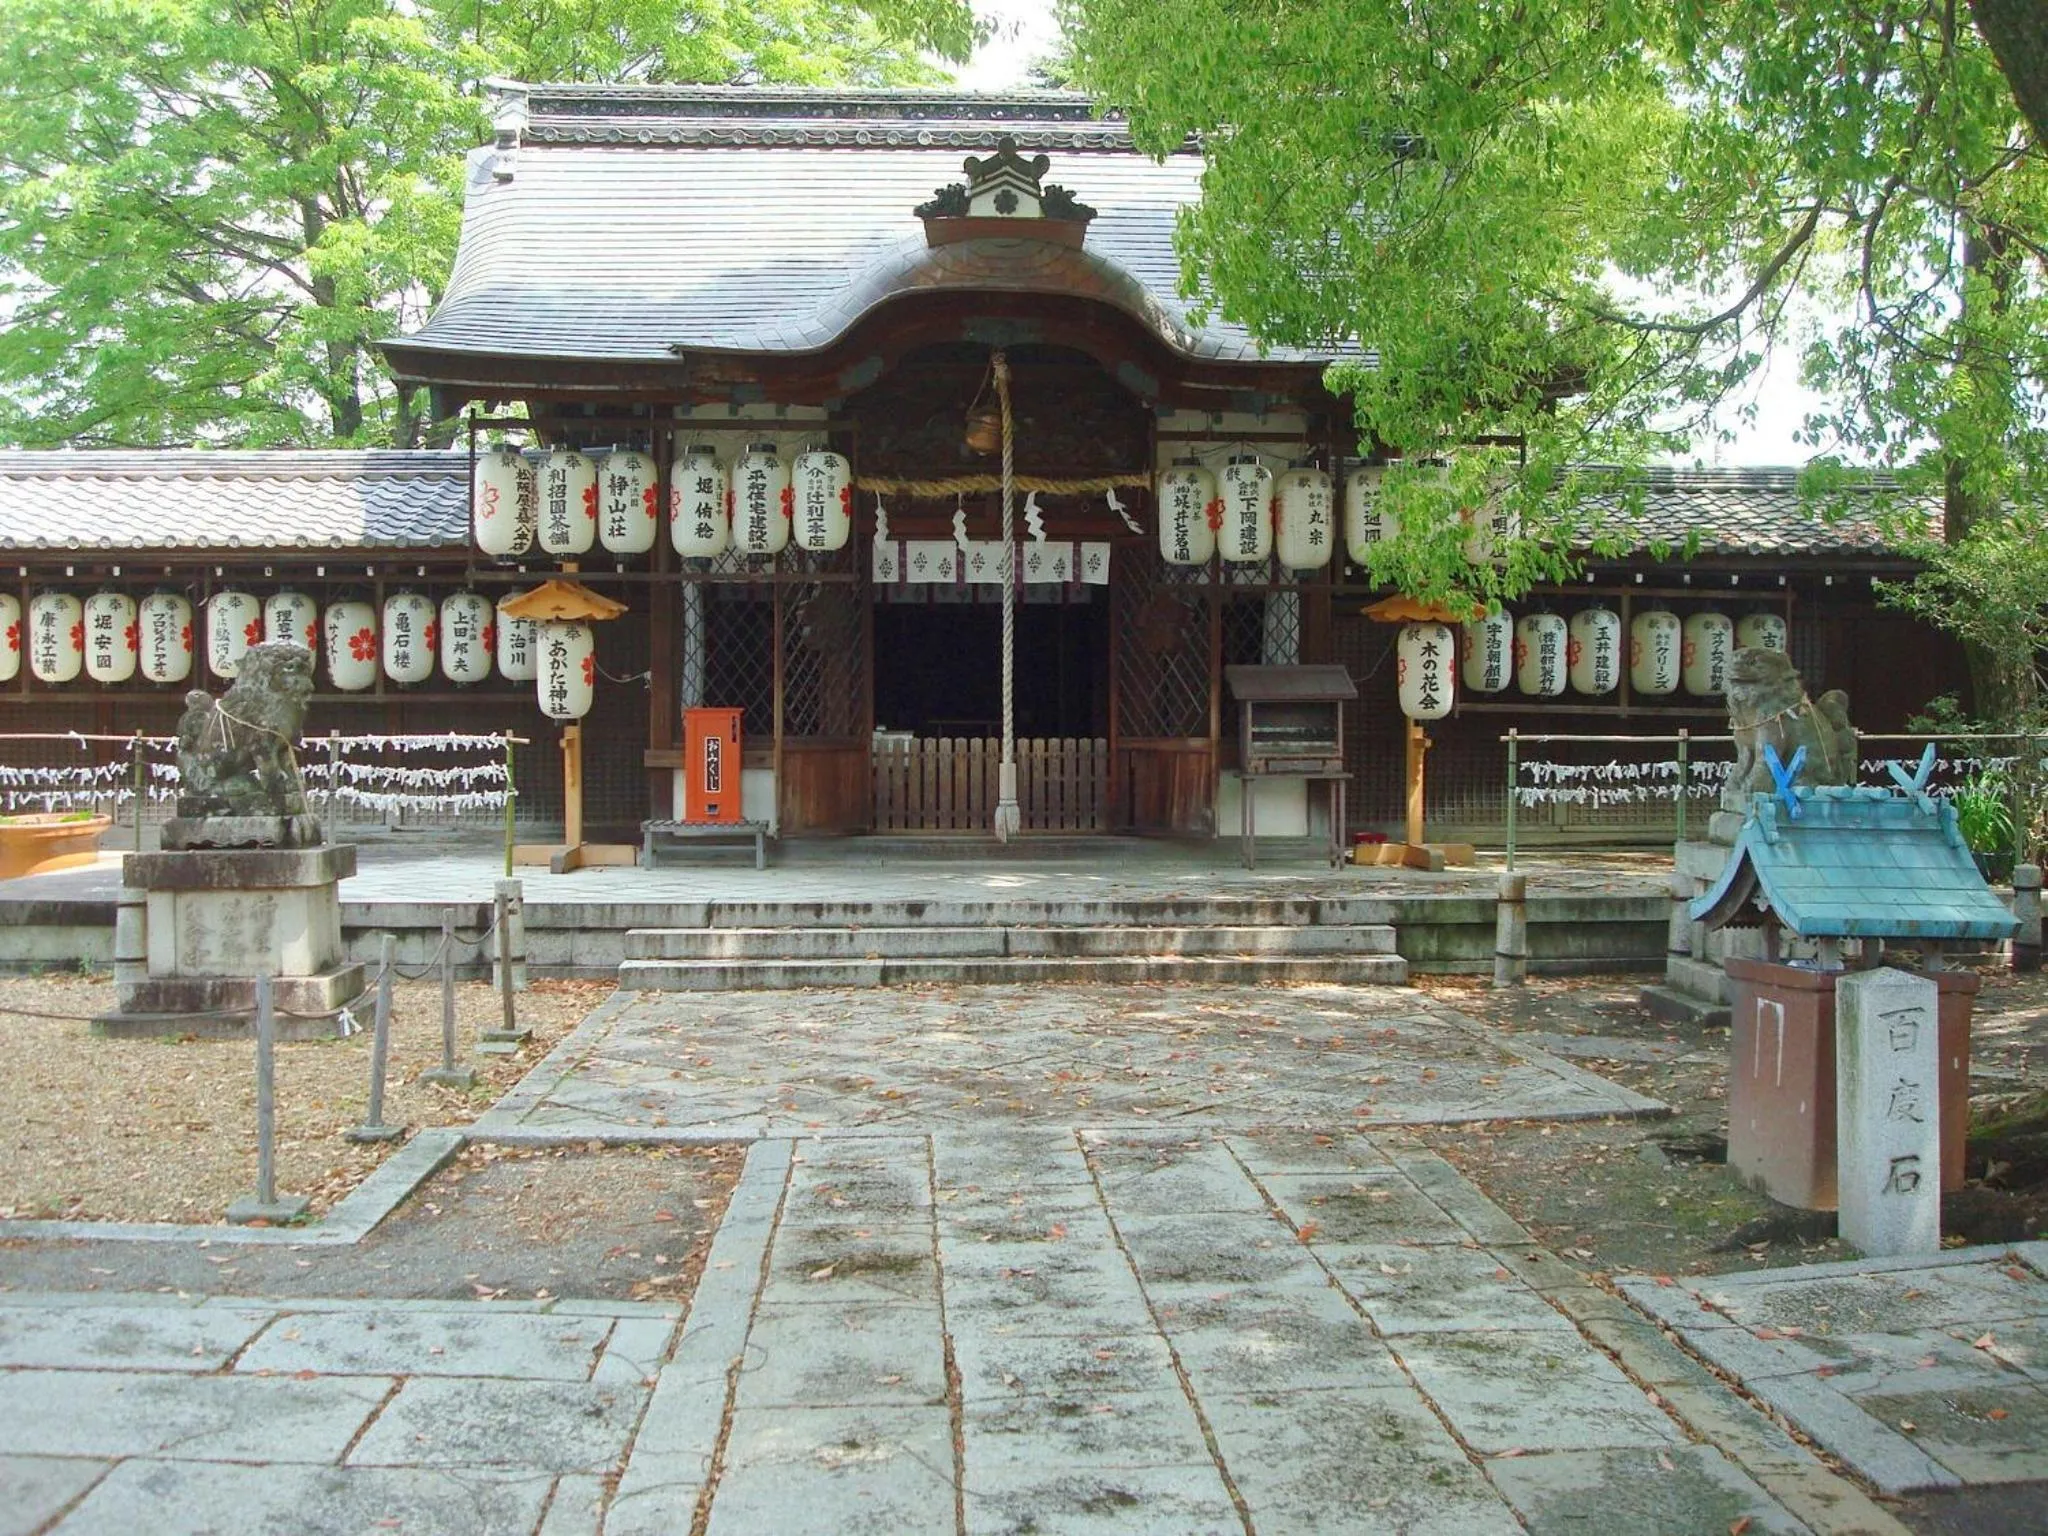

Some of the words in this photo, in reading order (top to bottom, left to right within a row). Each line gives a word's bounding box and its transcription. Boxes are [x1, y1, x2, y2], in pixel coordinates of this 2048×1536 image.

[608, 473, 629, 539] 静山荘
[1239, 497, 1259, 555] 下岡建設
[1307, 508, 1324, 546] 丸宗
[328, 623, 339, 665] サイトー
[548, 639, 572, 715] あがた神社
[1418, 641, 1441, 710] 木の花会
[708, 739, 719, 790] おみくじ
[1876, 1005, 1927, 1196] 百度石
